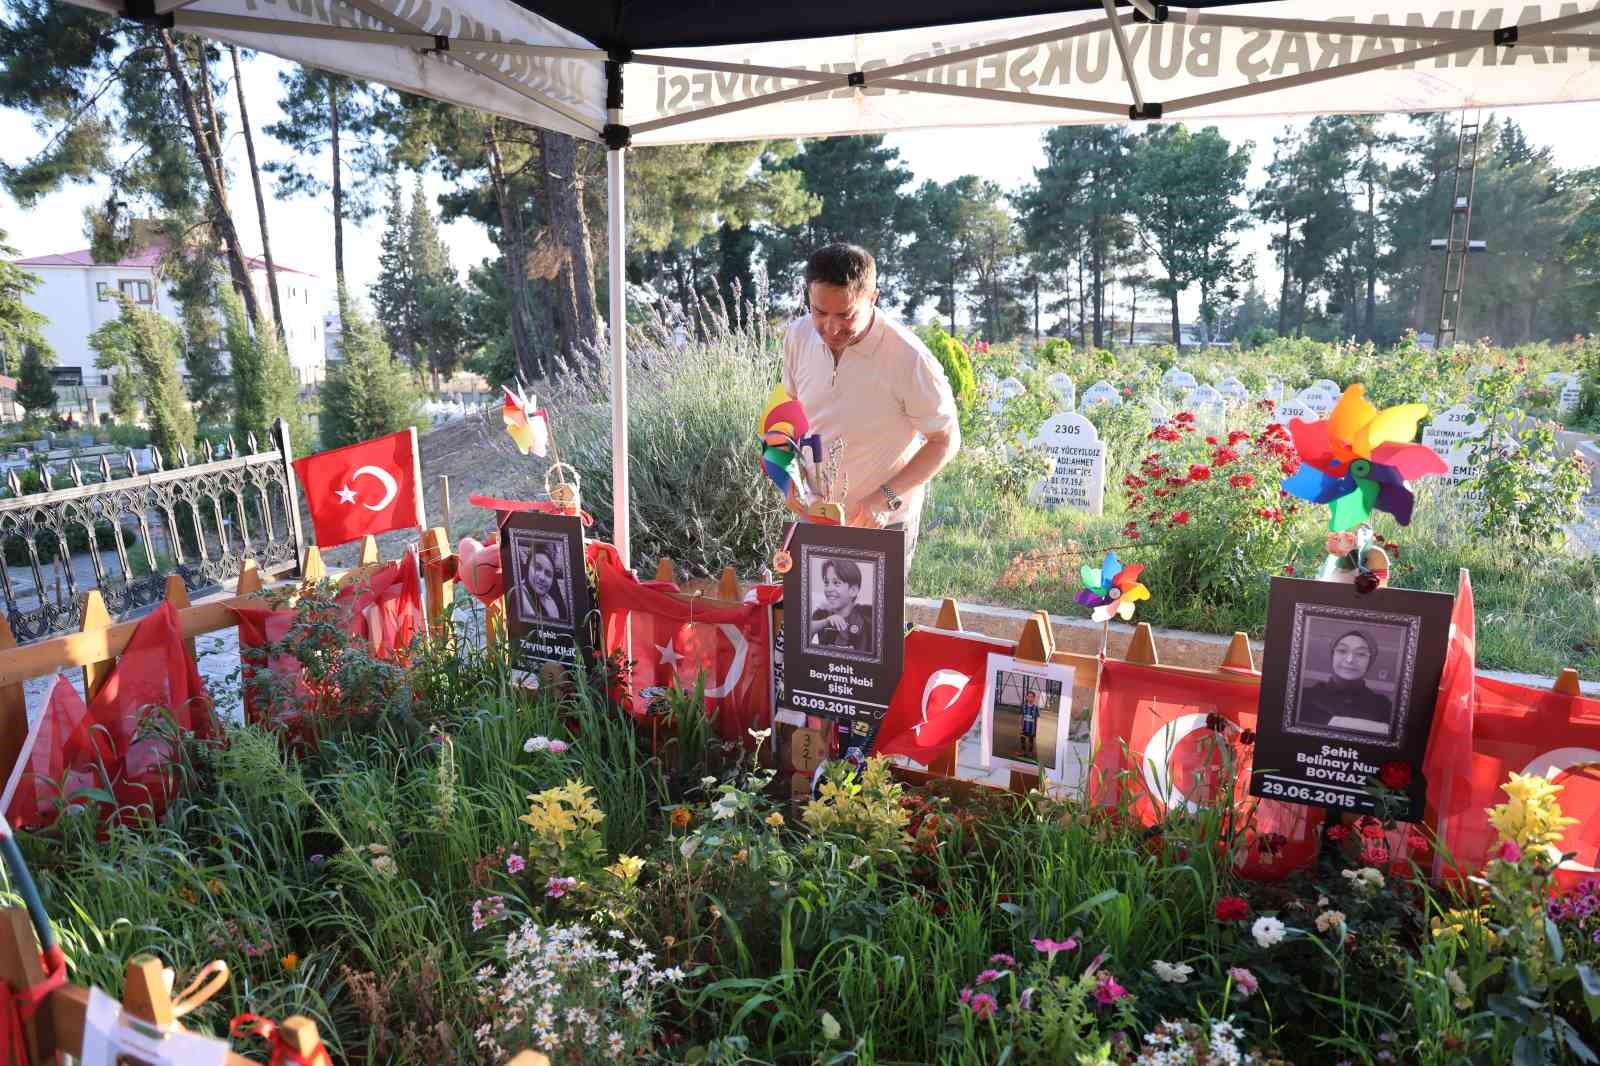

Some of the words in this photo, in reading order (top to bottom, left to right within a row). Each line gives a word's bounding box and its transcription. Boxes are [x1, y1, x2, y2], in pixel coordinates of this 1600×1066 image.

[1055, 424, 1081, 435] 2305
[520, 640, 553, 654] Zeynep
[828, 663, 855, 675] Şehit
[809, 669, 849, 684] Bayram
[850, 675, 874, 688] Nabi
[792, 695, 856, 716] 03.09.2015
[1321, 745, 1359, 760] Şehit
[1296, 752, 1350, 772] Belinay
[1353, 761, 1380, 774] Nur
[1306, 767, 1367, 785] BOYRAZ
[1262, 781, 1356, 807] 29.06.2015
